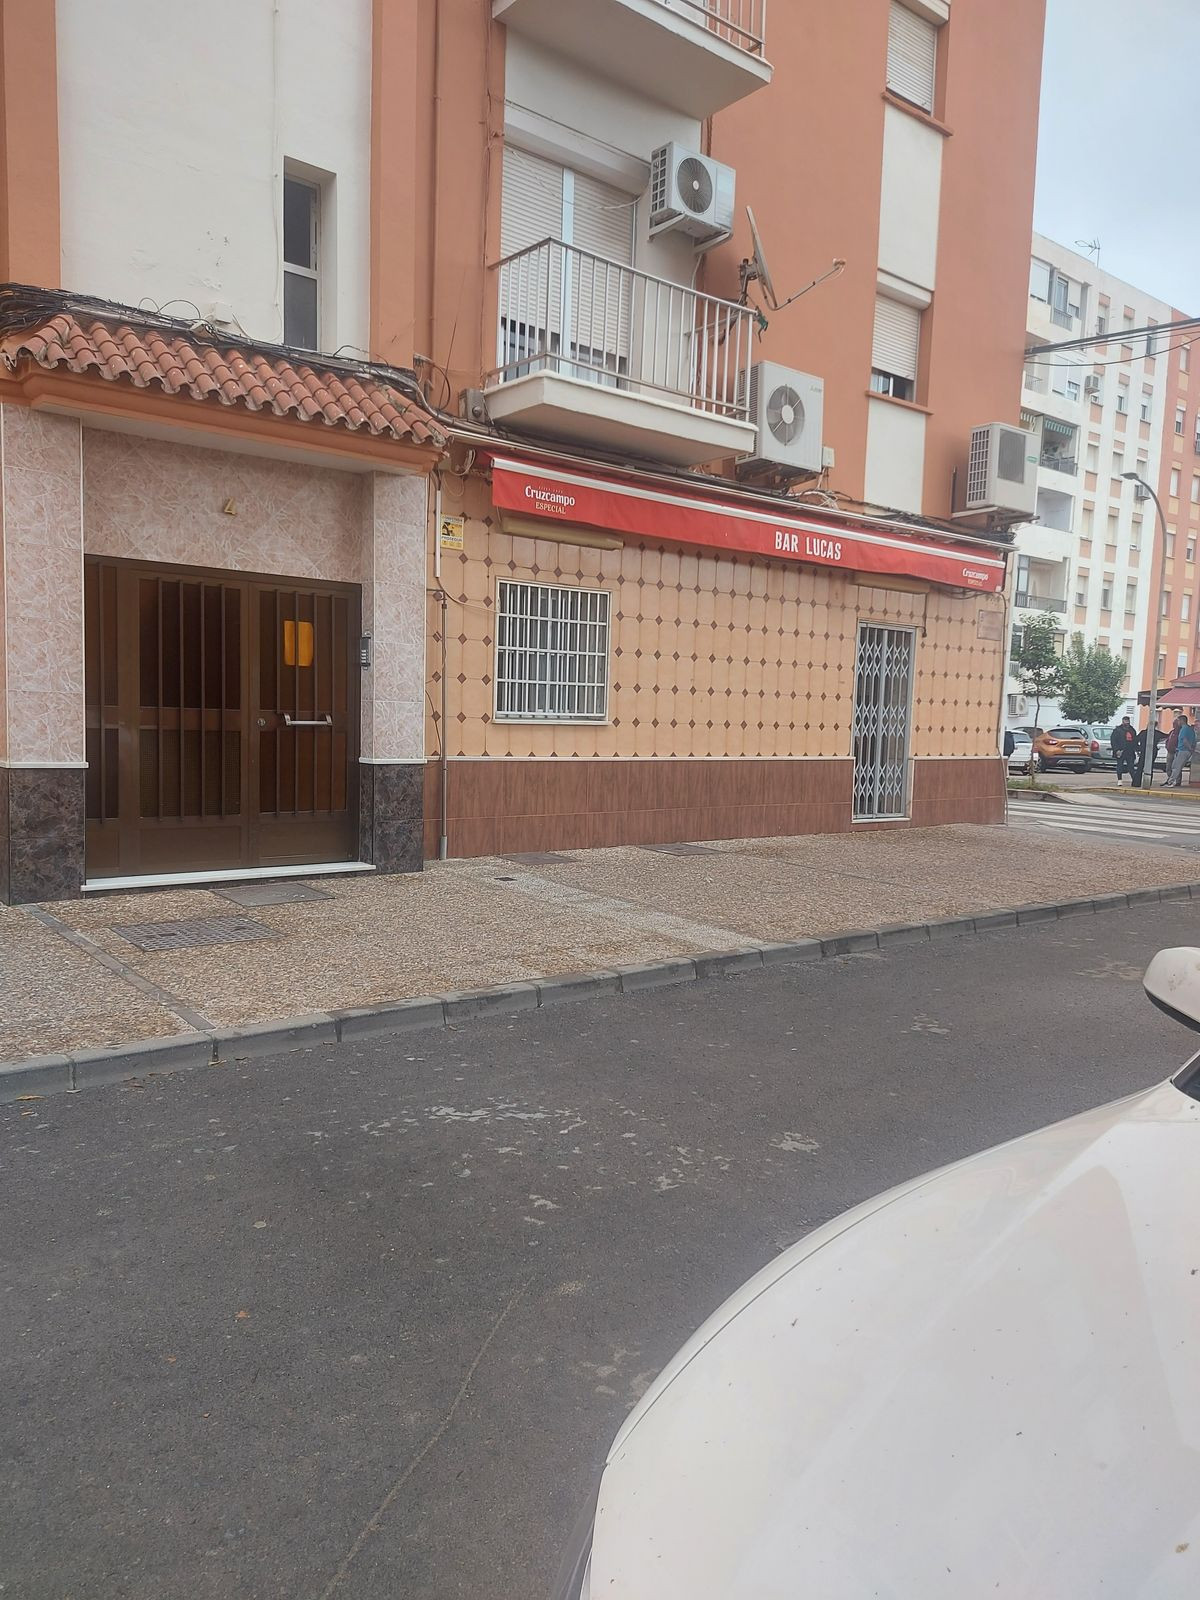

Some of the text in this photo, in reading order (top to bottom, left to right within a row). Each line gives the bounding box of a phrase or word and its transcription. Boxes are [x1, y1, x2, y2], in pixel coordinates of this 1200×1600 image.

[224, 497, 236, 515] 4
[525, 485, 575, 507] Cruzcampo
[535, 501, 566, 515] ESPECIAL
[775, 531, 841, 560] BAR LUCAS
